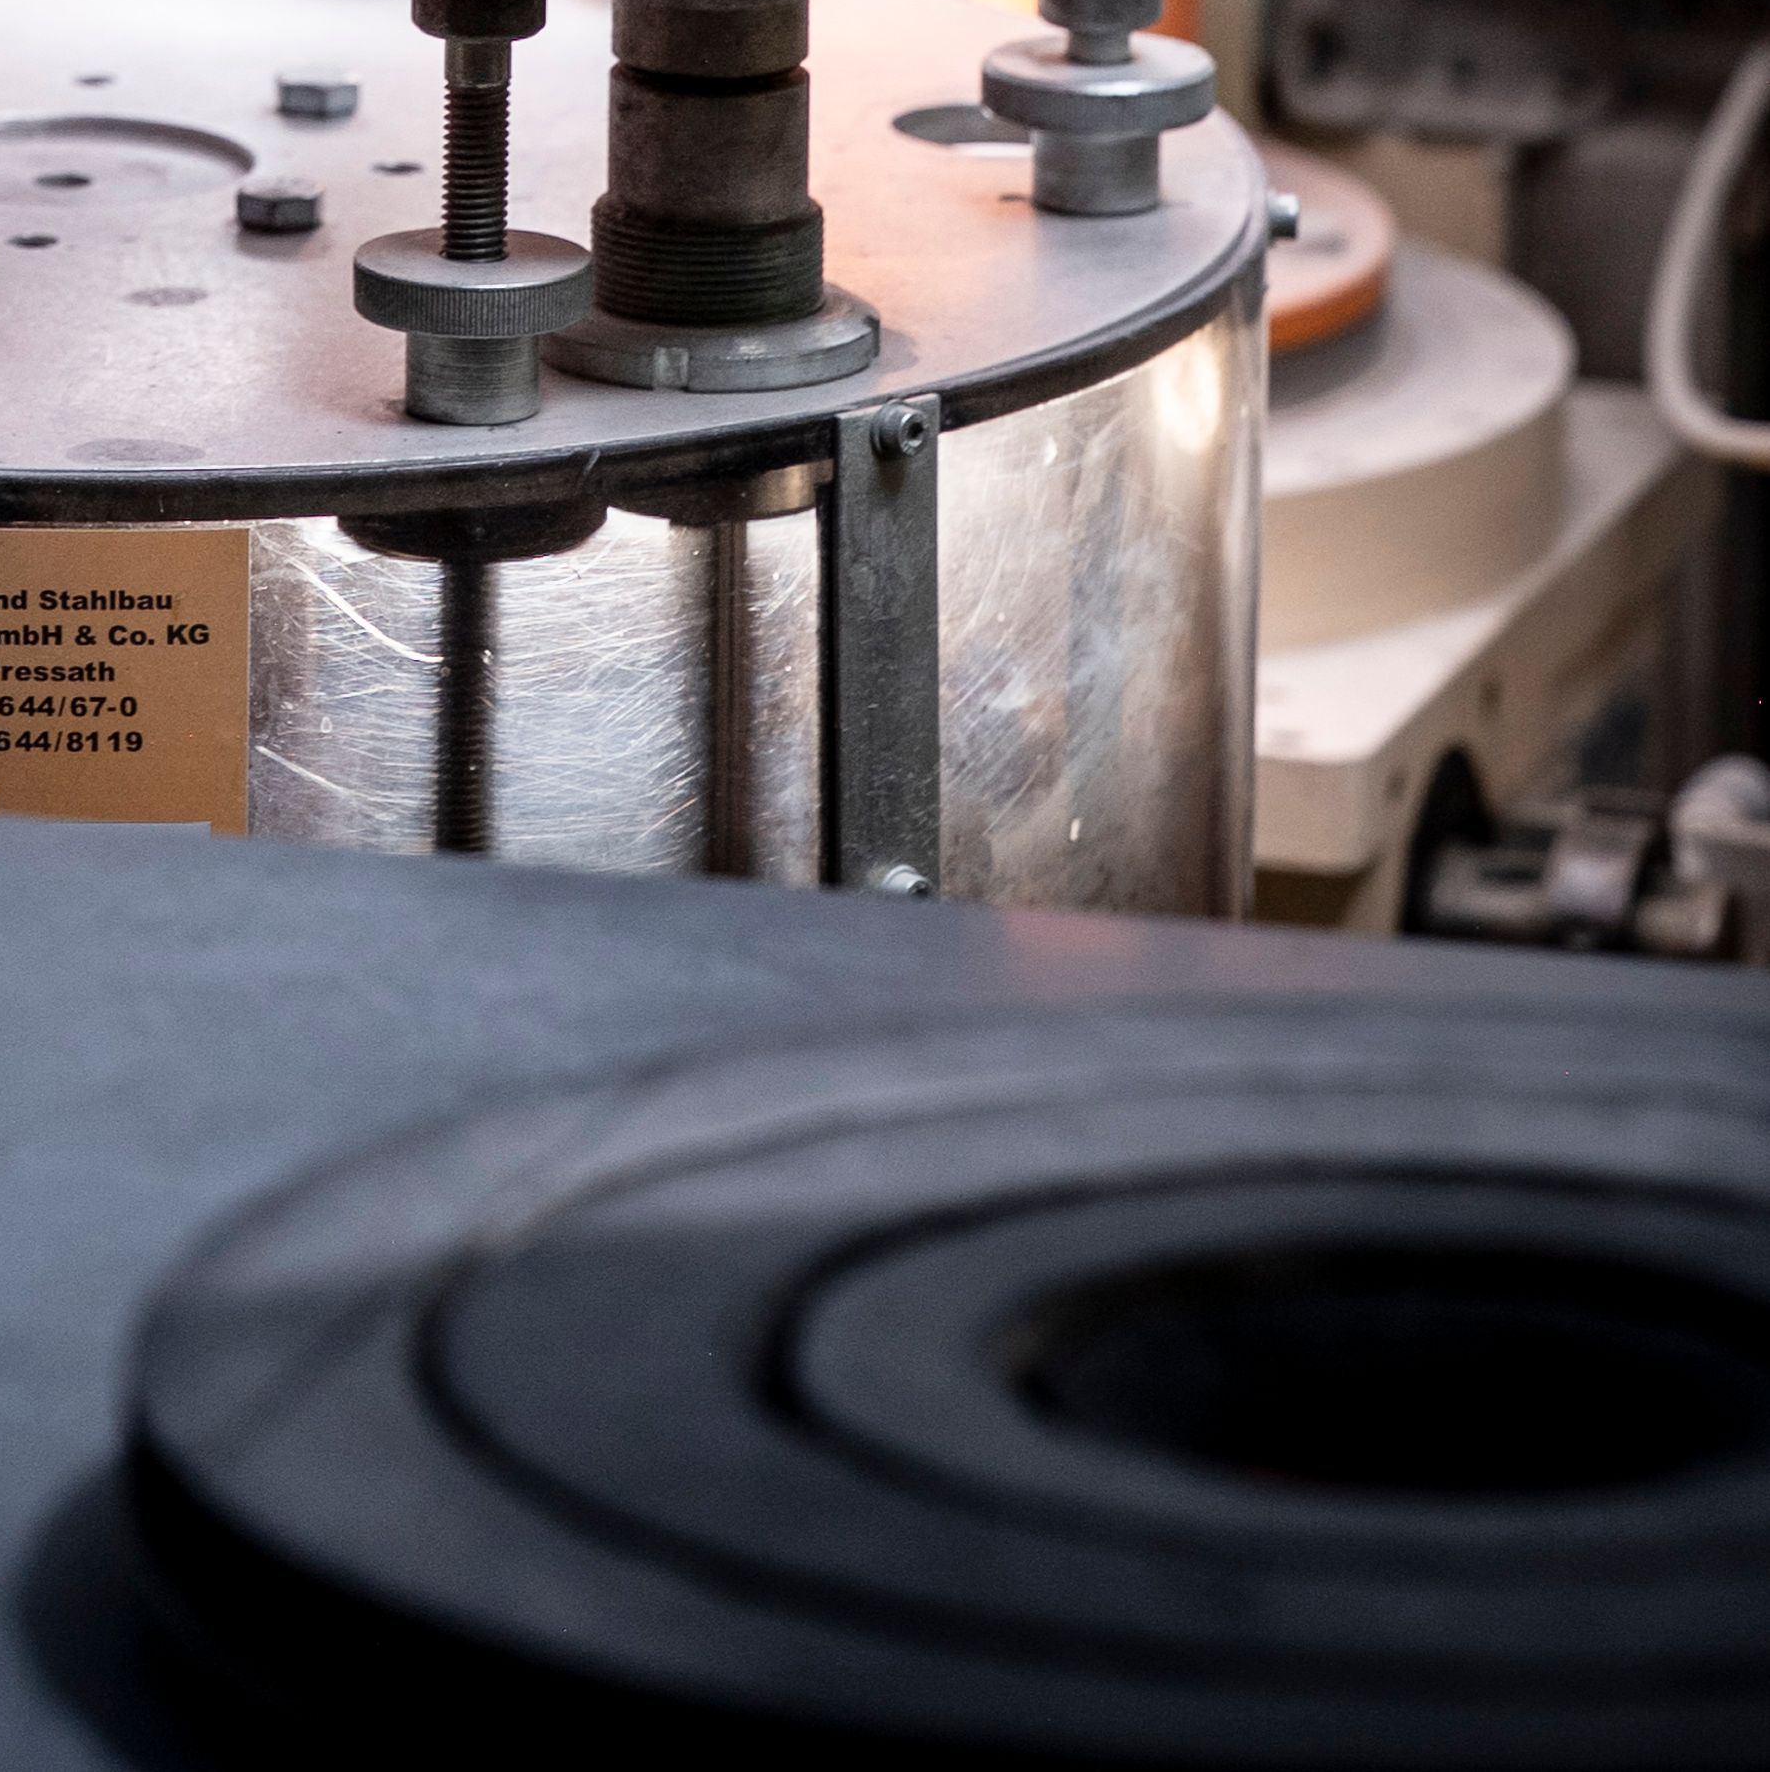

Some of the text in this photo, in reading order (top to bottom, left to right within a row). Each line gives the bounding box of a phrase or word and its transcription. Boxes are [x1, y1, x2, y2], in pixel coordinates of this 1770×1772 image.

[38, 589, 173, 611] Stahlbau
[74, 624, 97, 646] &
[107, 624, 155, 646] Co.
[166, 623, 210, 646] KG
